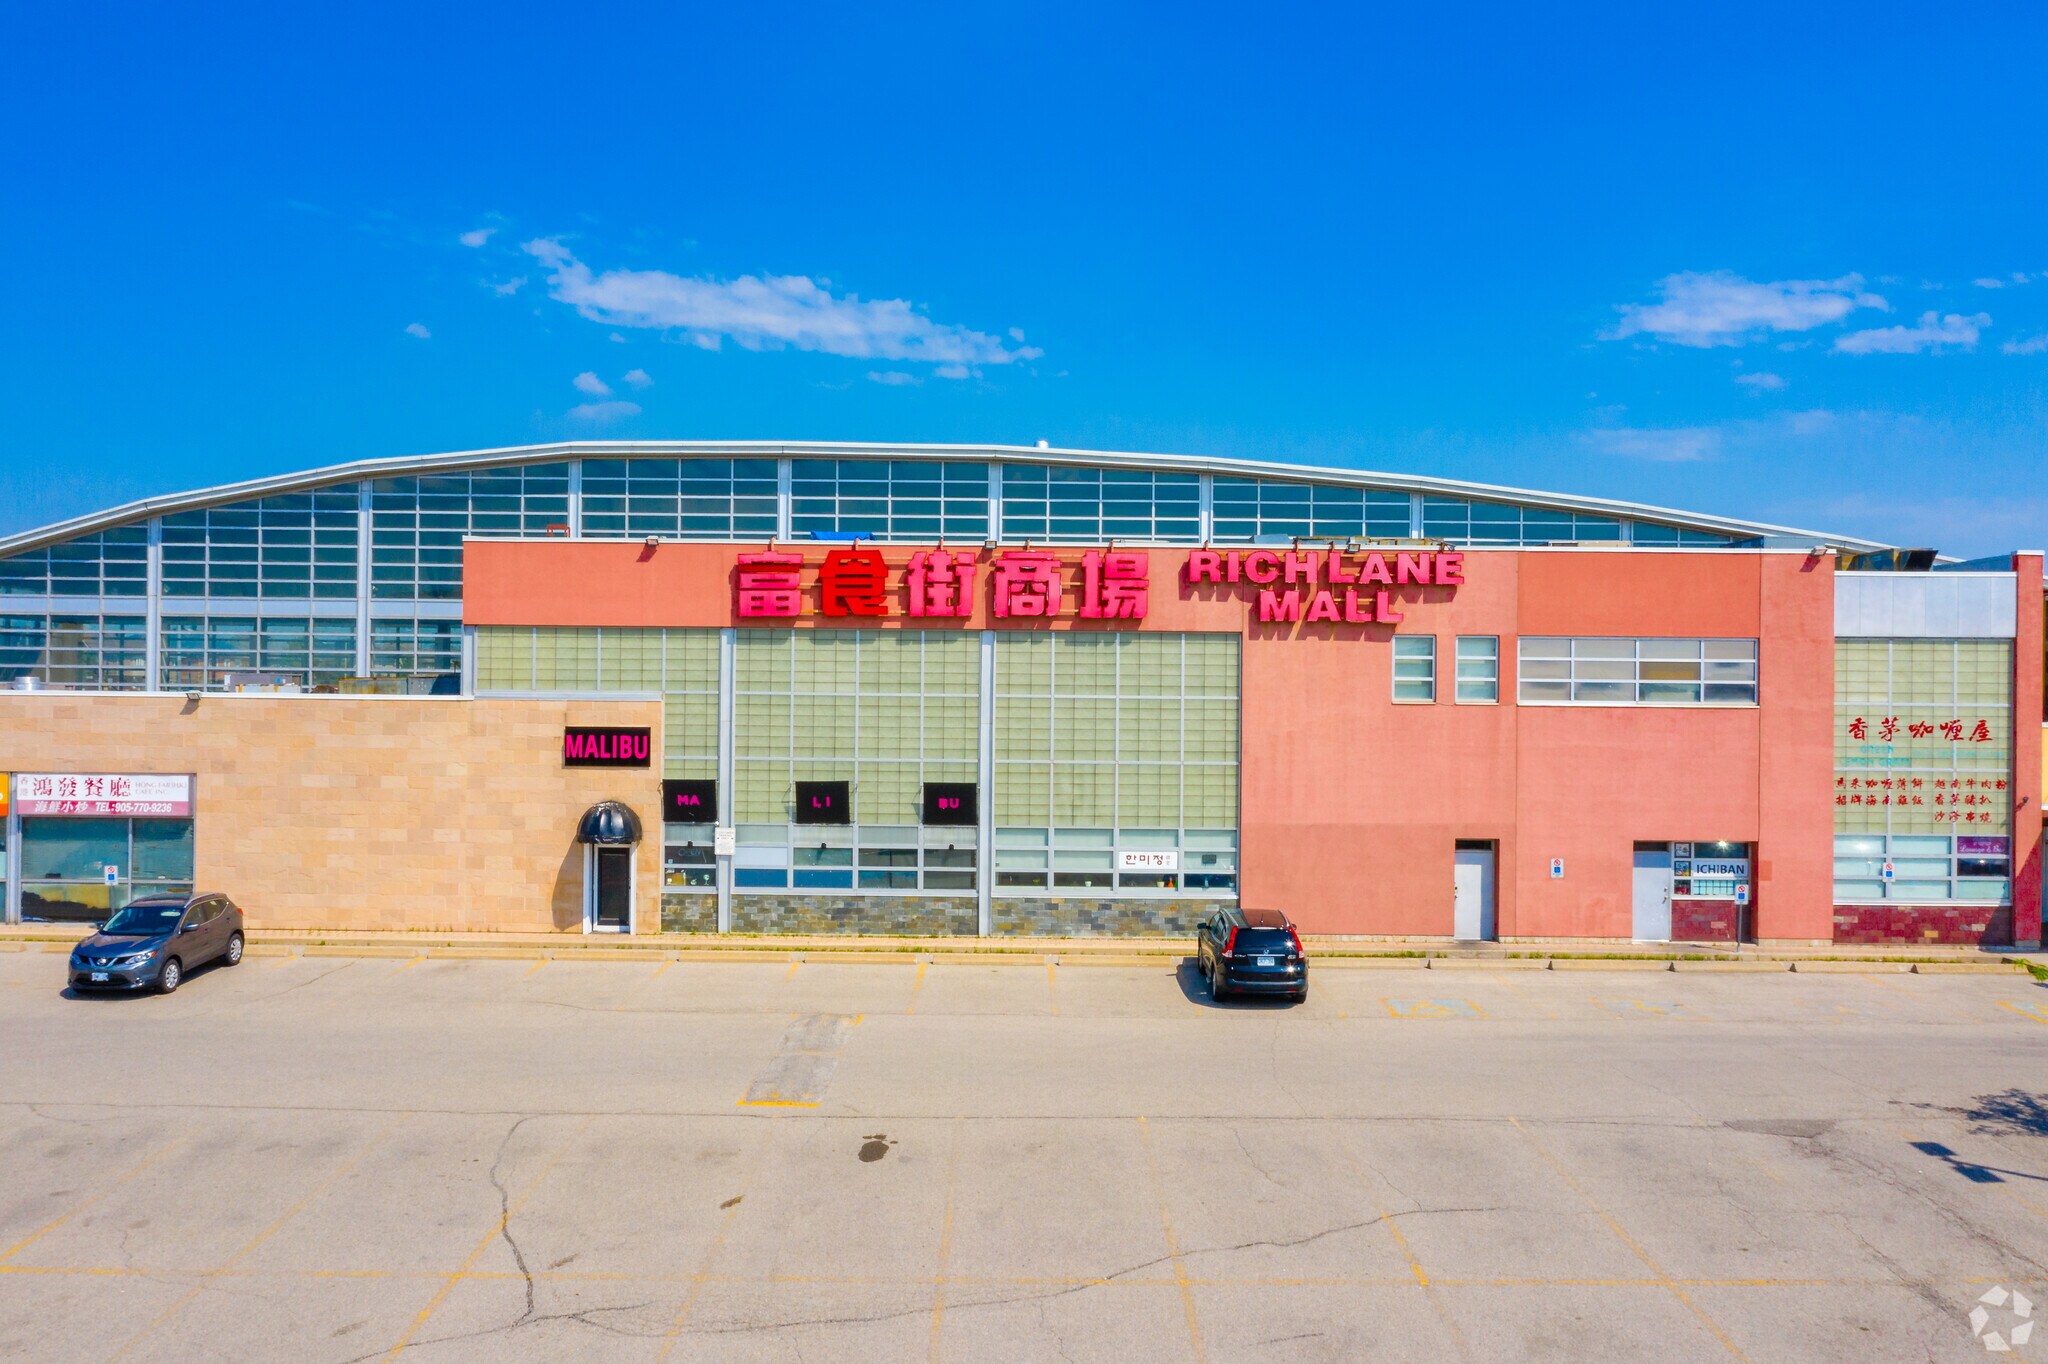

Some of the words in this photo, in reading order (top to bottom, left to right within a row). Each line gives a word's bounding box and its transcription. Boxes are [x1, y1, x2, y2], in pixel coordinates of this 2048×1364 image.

[737, 549, 1150, 619] 富食街商場
[1259, 590, 1404, 622] MALL
[565, 734, 649, 759] MALIBU
[33, 777, 131, 797] 鴻發餐廳
[677, 794, 700, 806] MA
[938, 798, 959, 808] BU
[1126, 854, 1164, 866] 한미정
